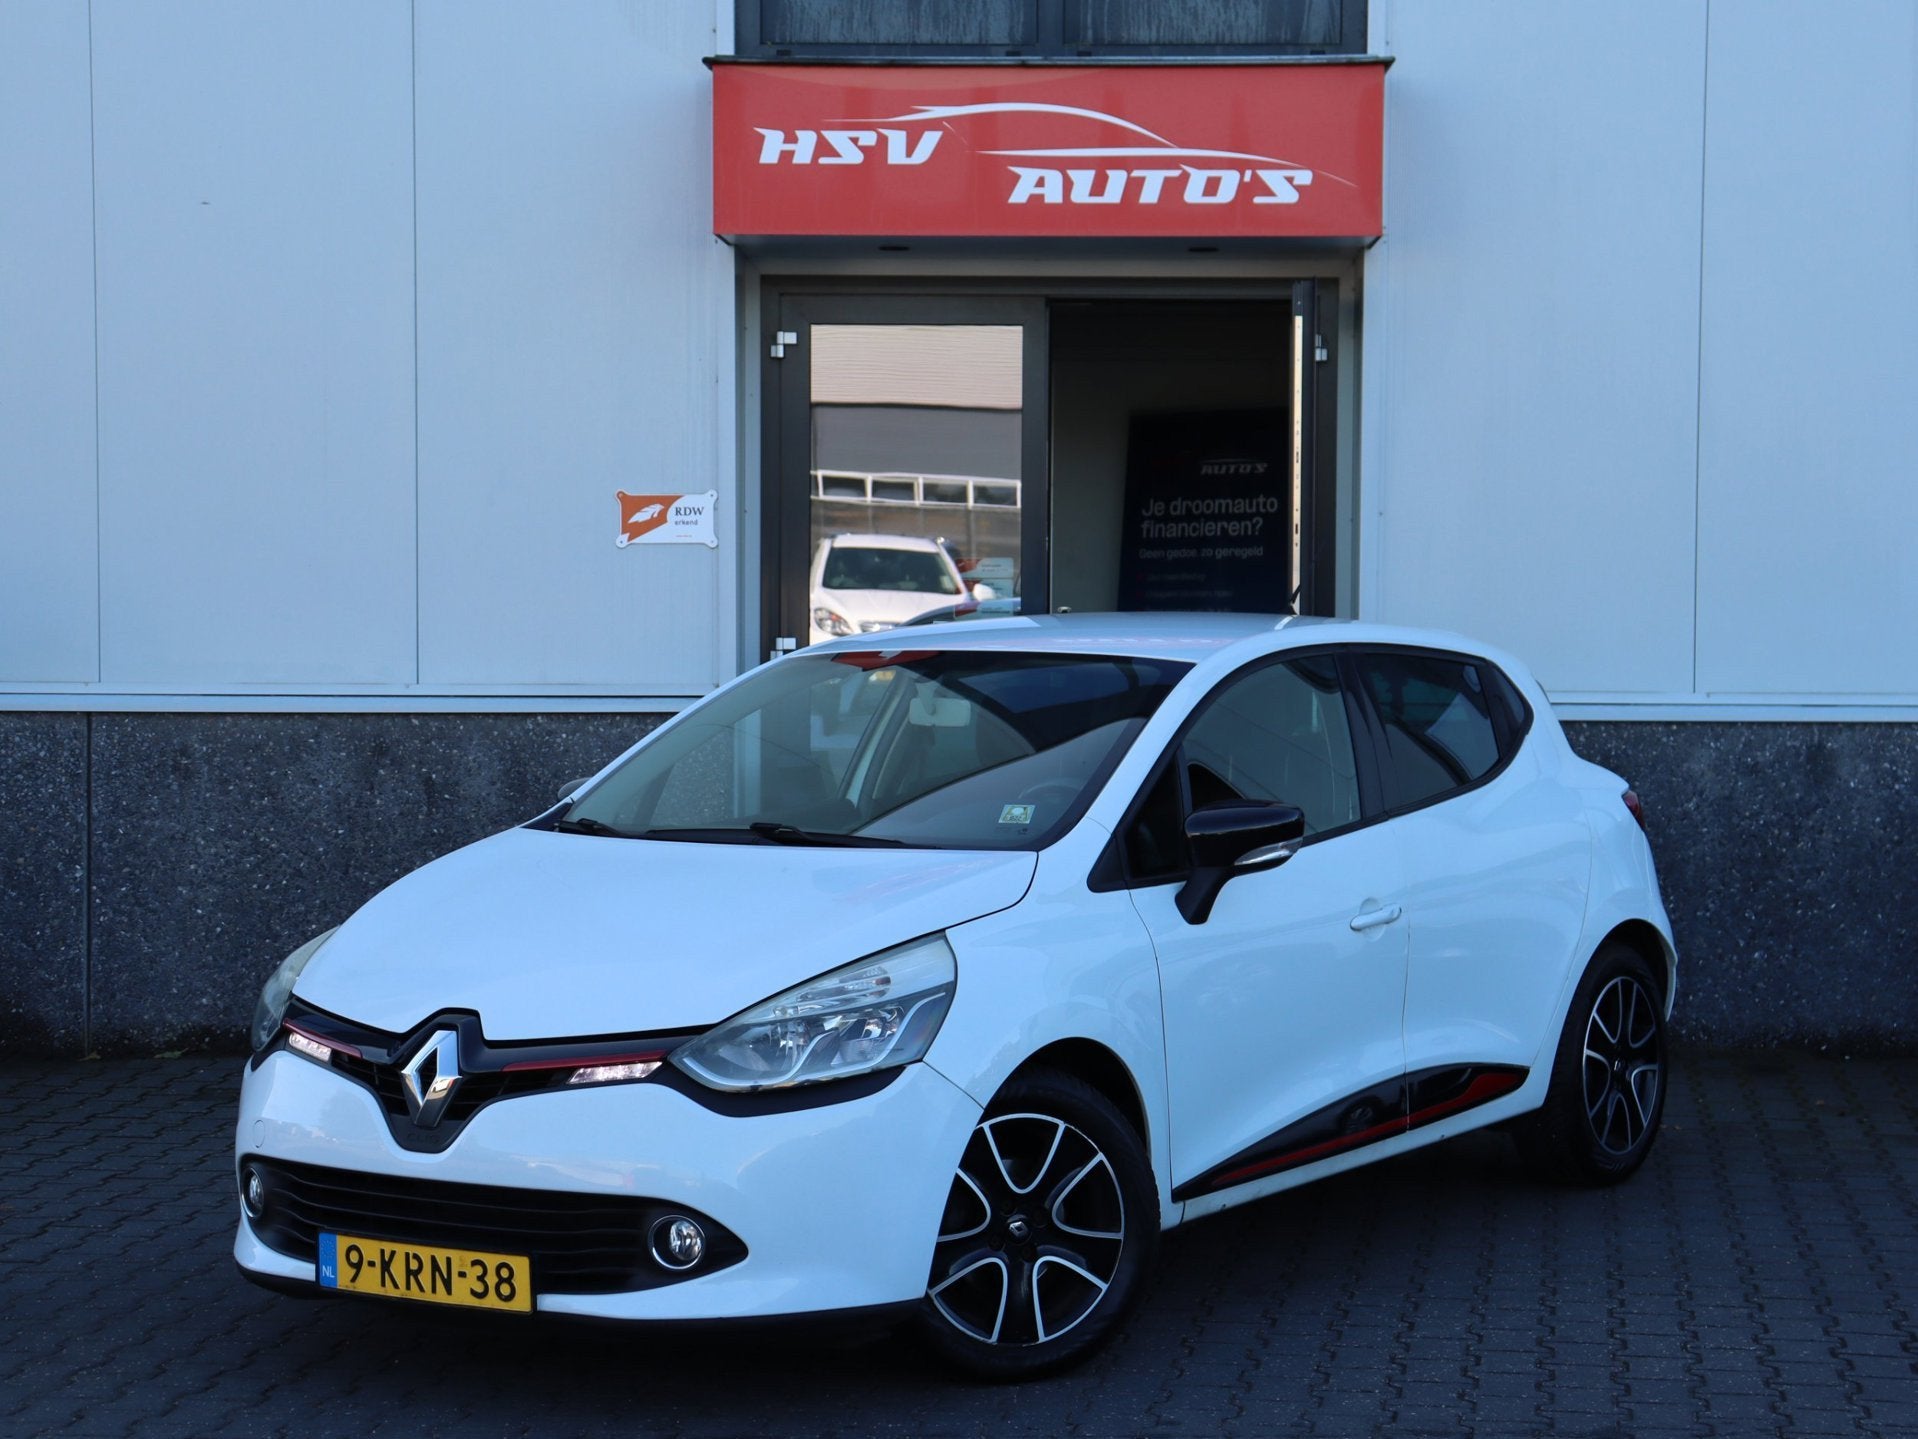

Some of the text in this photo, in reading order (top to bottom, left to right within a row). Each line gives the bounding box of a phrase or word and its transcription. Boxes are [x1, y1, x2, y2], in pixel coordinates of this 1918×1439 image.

[753, 127, 943, 165] HSV
[1006, 163, 1313, 204] AUTO'S
[675, 506, 704, 516] RDW
[1142, 494, 1279, 517] Je droomauto
[1141, 517, 1264, 538] financieren?
[322, 1244, 517, 1302] NL 9-KRN-38
